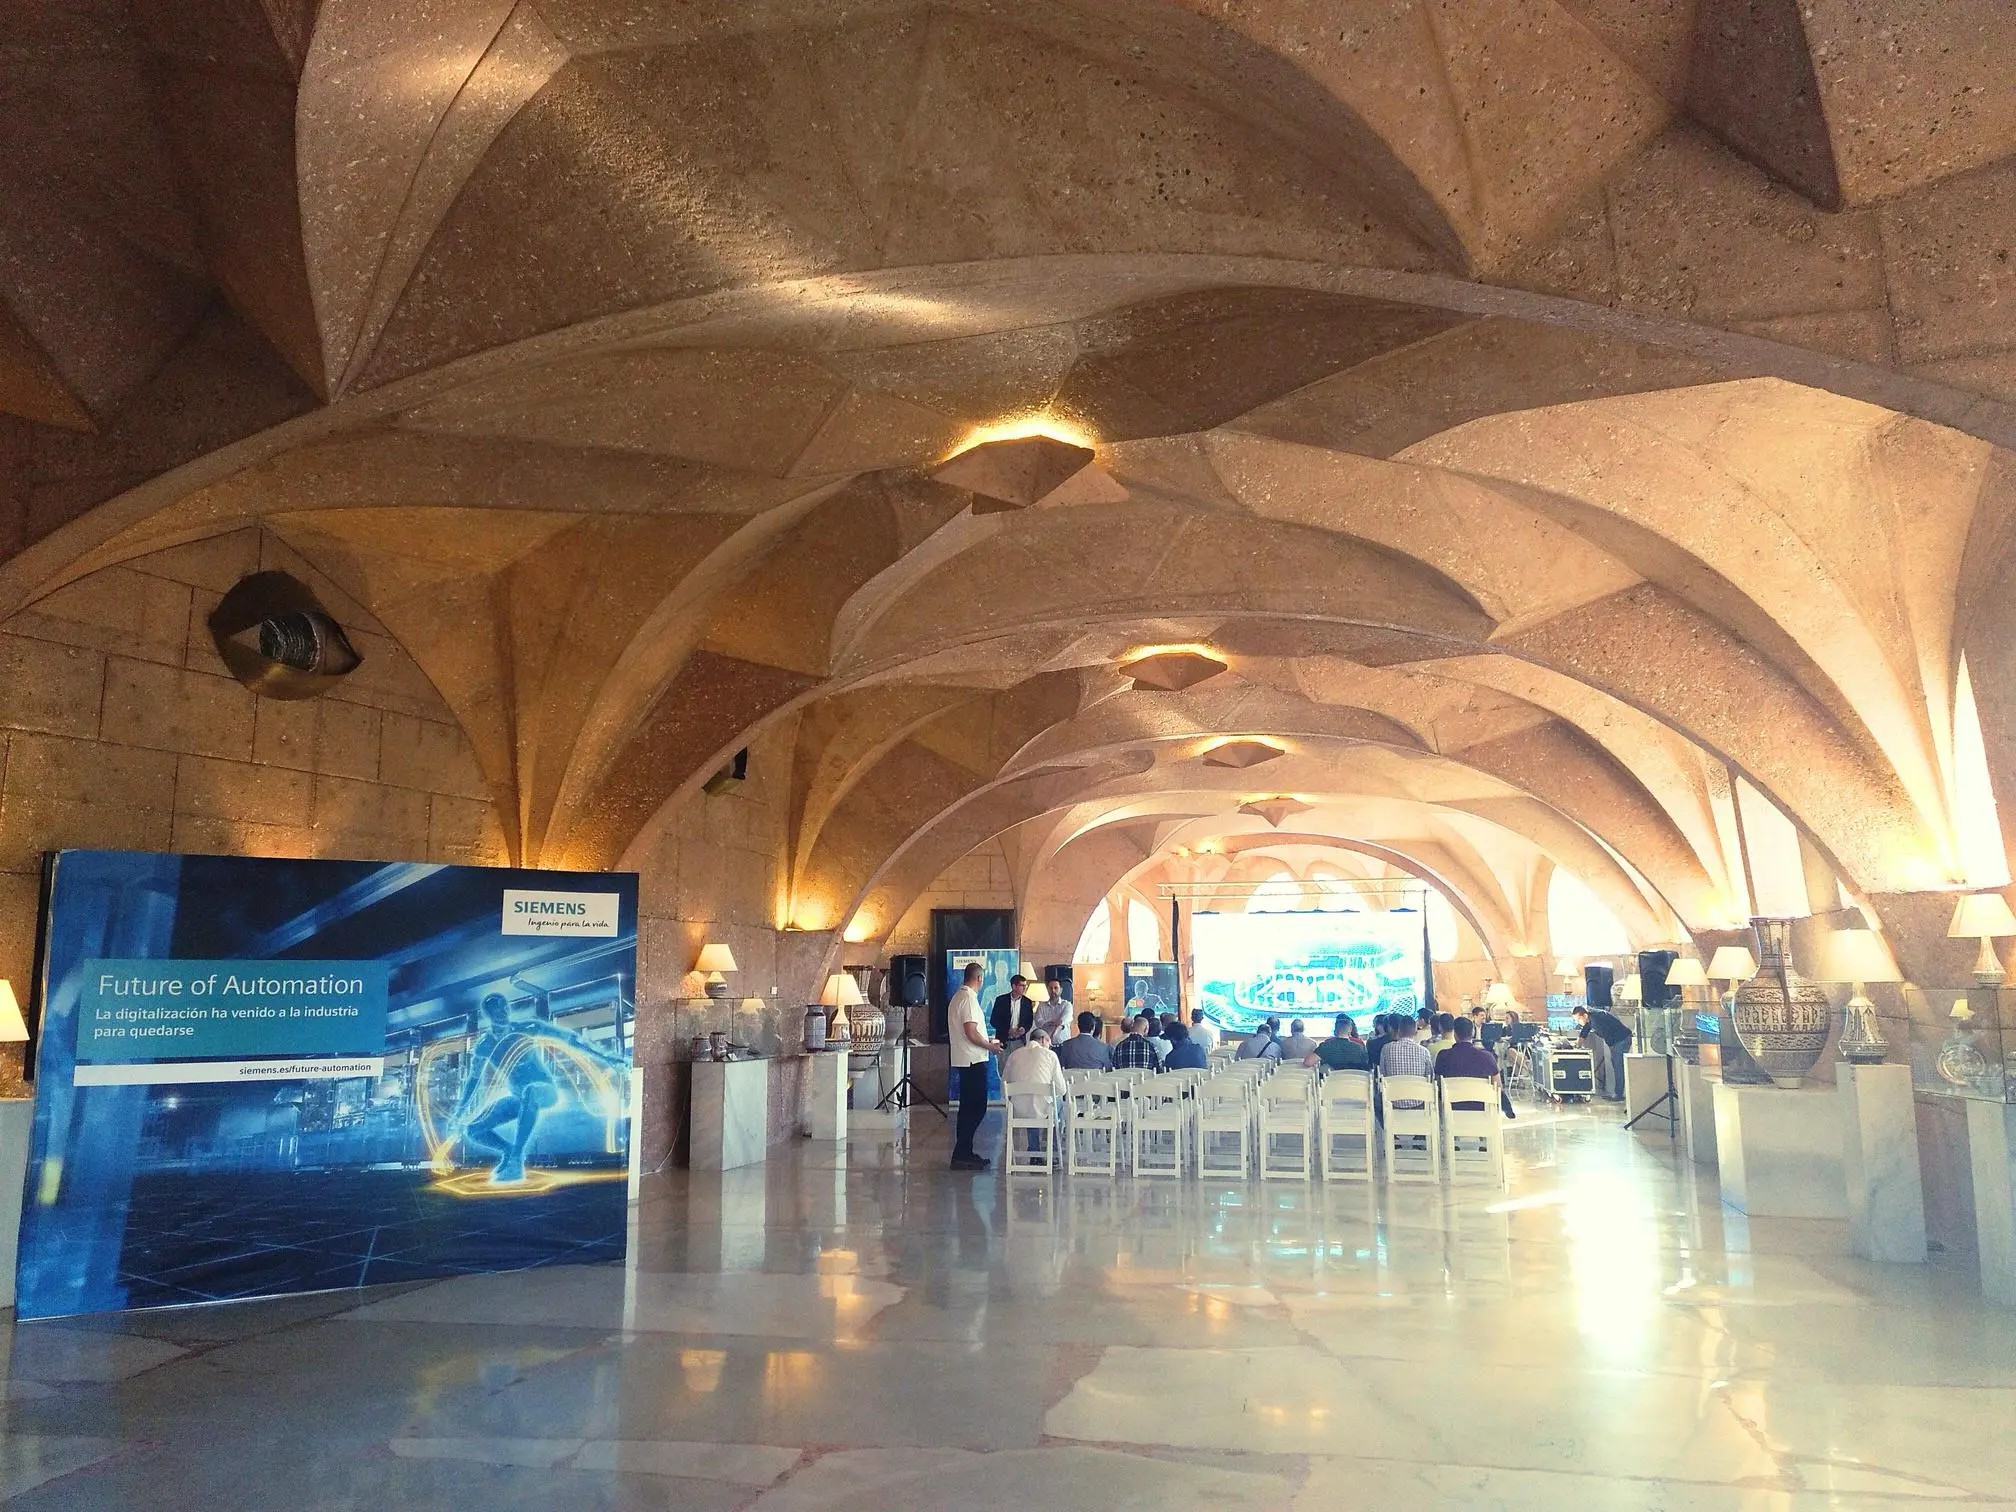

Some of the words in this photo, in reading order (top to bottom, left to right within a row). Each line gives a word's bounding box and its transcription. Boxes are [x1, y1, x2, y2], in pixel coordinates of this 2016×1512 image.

[514, 901, 586, 915] SIEMENS
[528, 918, 559, 931] Ingenio
[560, 921, 581, 929] para
[581, 920, 591, 928] la
[592, 920, 610, 928] vida
[99, 975, 183, 996] Future
[190, 974, 218, 995] of
[222, 974, 363, 995] Automation
[95, 1008, 111, 1020] La
[115, 1007, 207, 1022] digitalización
[211, 1007, 227, 1018] ha
[231, 1007, 276, 1018] venido
[278, 1009, 286, 1017] a
[289, 1006, 301, 1017] la
[304, 1005, 359, 1017] industria
[94, 1027, 126, 1040] para
[129, 1025, 194, 1039] quedarse
[239, 1063, 372, 1075] siemens.es/future-automation
